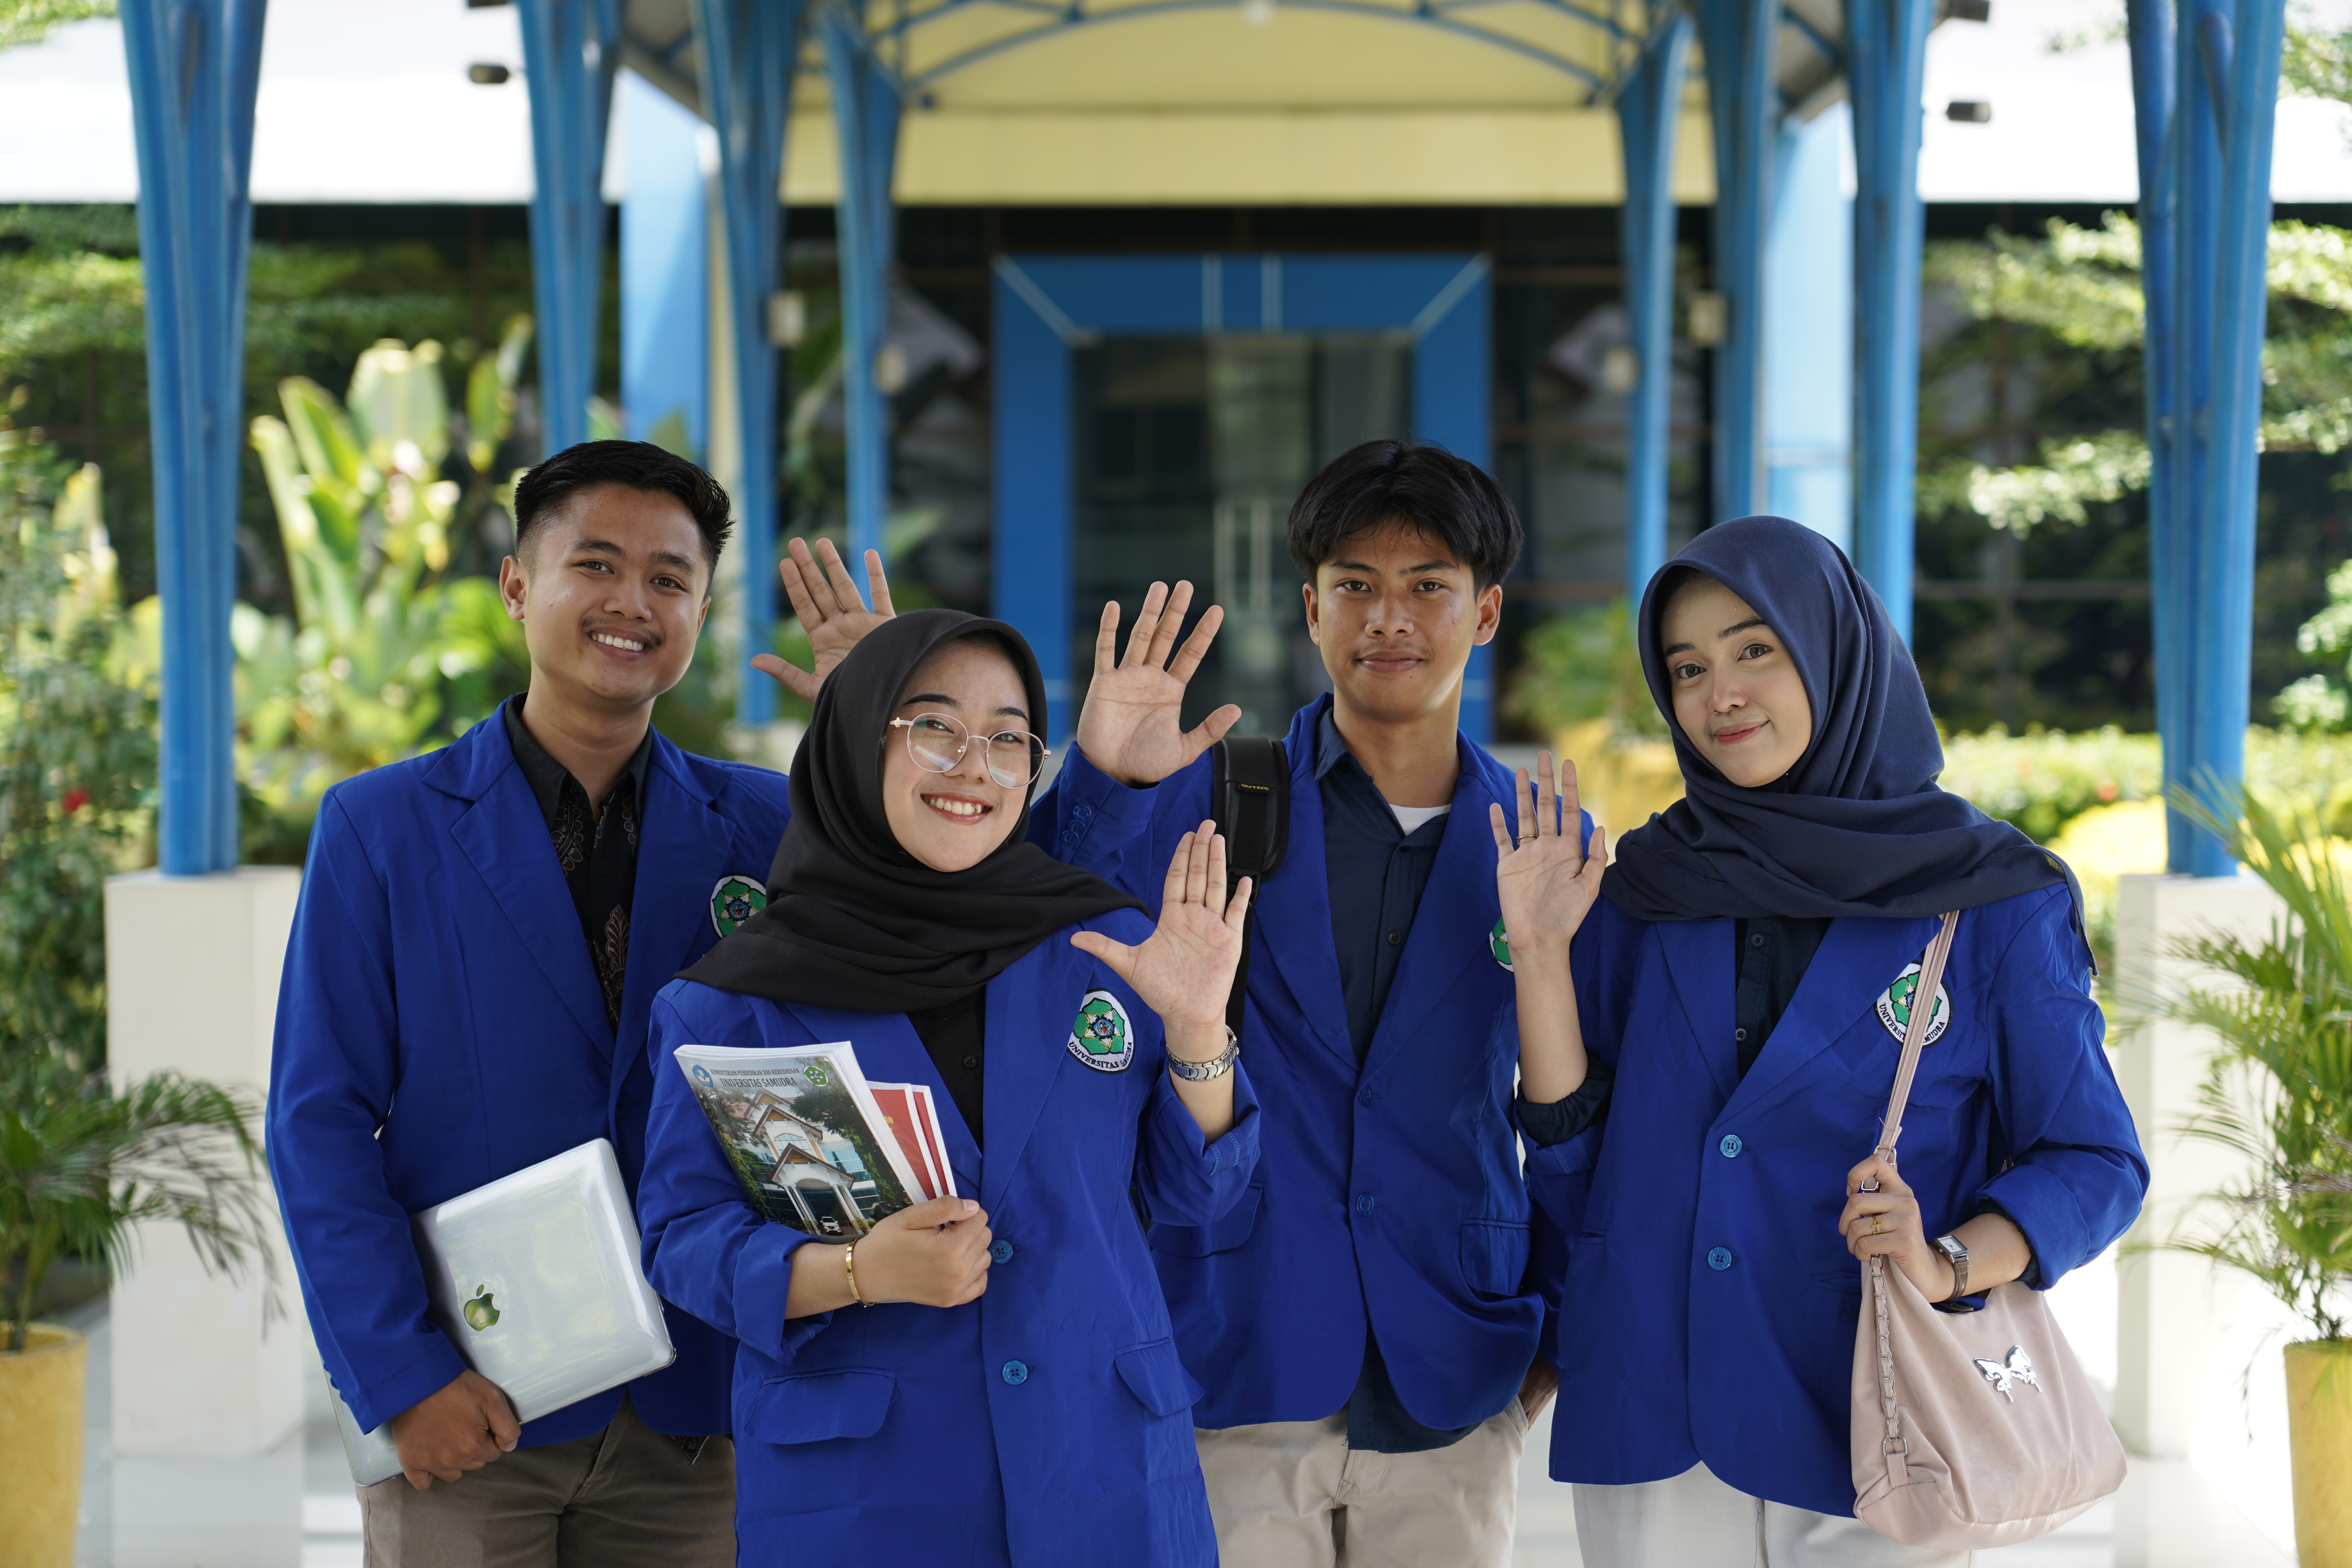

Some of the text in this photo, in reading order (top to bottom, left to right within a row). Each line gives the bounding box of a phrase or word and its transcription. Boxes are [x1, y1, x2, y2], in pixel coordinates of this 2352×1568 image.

[1880, 1002, 1945, 1043] UNIVERSIT MUDRA
[1069, 1041, 1119, 1068] UNIVERSITAS
[719, 1077, 798, 1087] UNIVERSITAS SAMUDRA
